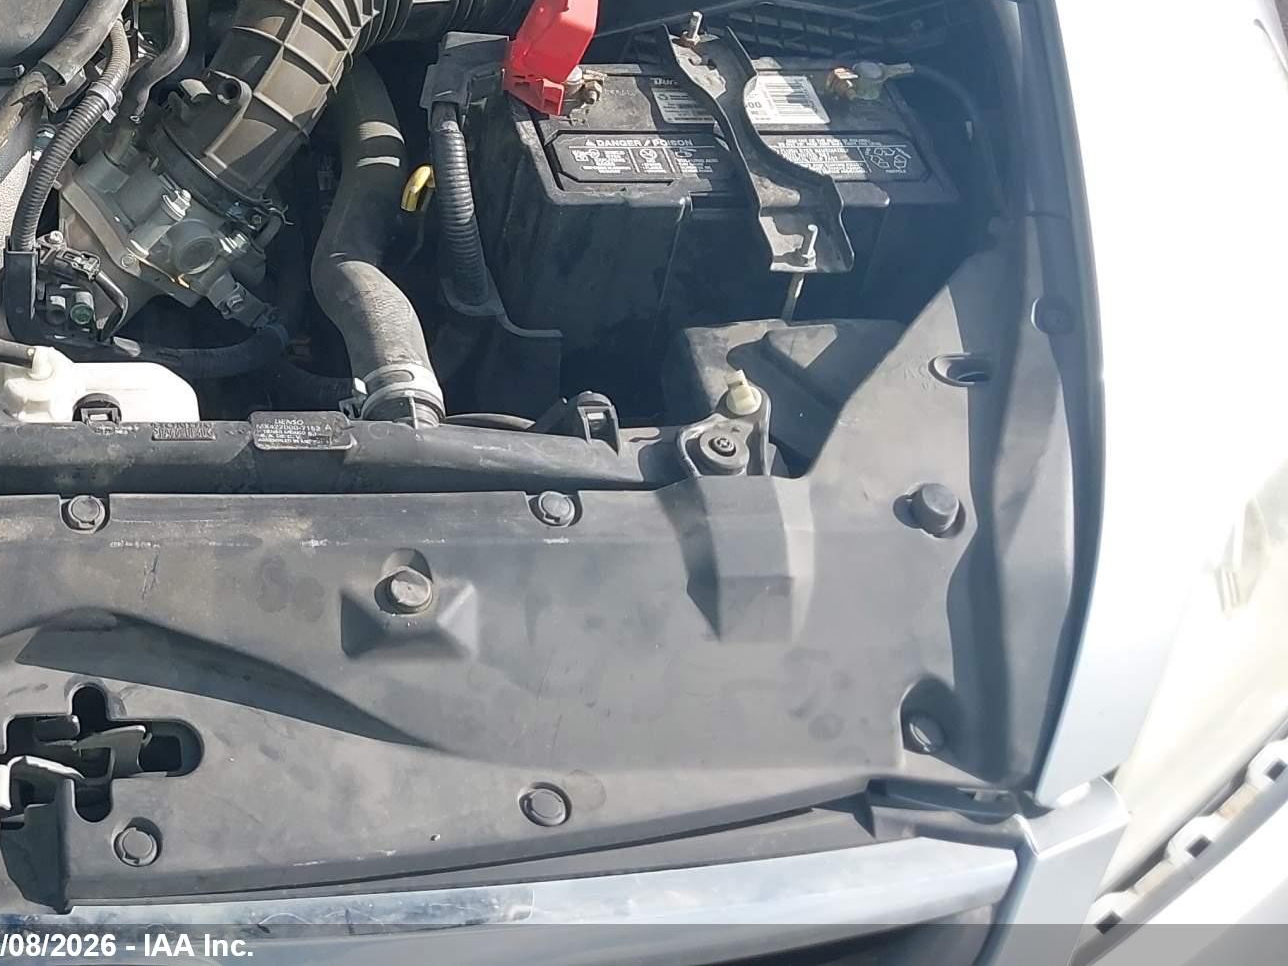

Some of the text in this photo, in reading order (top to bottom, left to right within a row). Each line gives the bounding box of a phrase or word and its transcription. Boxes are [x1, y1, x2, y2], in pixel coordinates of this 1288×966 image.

[596, 139, 642, 147] DANGER
[653, 139, 694, 147] POISON
[273, 418, 305, 426] DENSO
